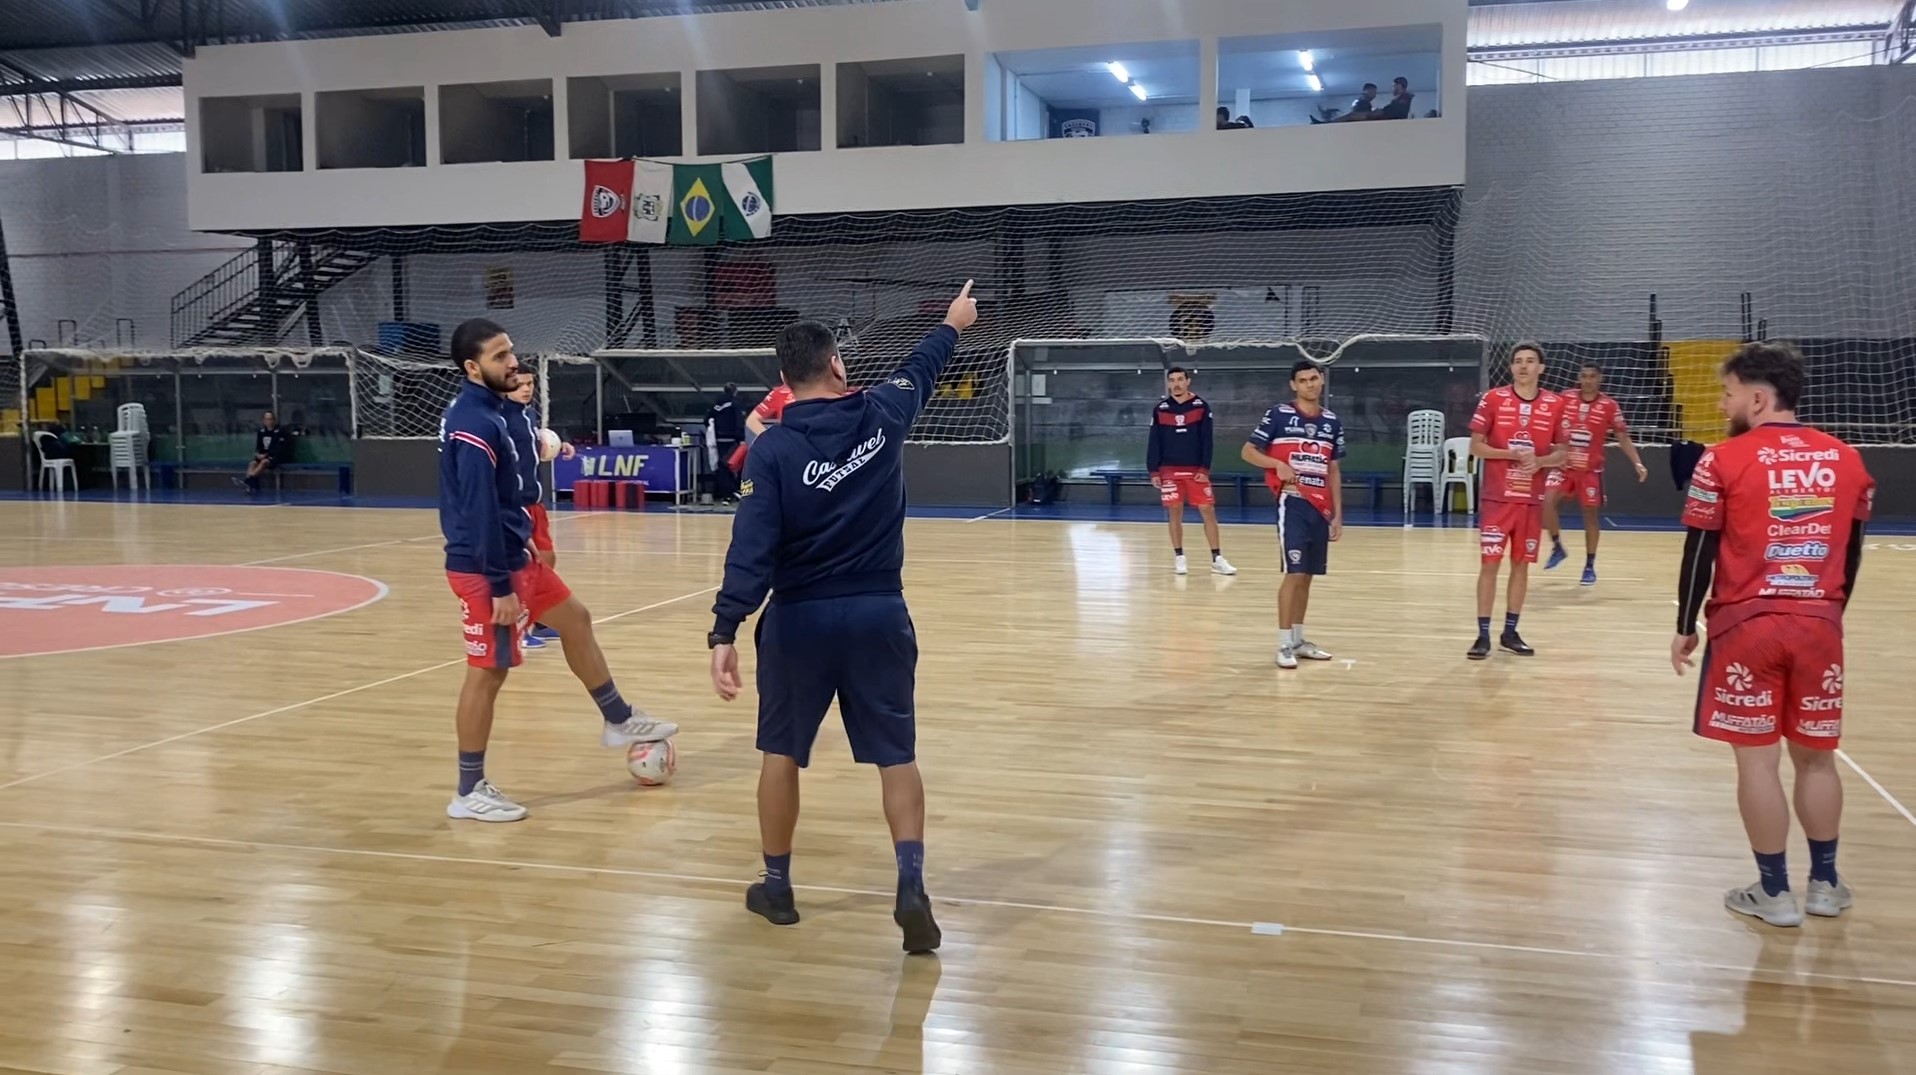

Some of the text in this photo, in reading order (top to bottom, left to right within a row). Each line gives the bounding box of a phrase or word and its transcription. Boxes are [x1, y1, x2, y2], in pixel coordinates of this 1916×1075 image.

[1778, 448, 1840, 462] Sicredi
[598, 454, 649, 477] LNF
[1768, 462, 1836, 489] LEVO
[1765, 542, 1829, 559] Duetto
[1714, 687, 1773, 708] Sicredi
[1799, 696, 1843, 711] Sicre
[1711, 710, 1776, 728] MUFFATÃO
